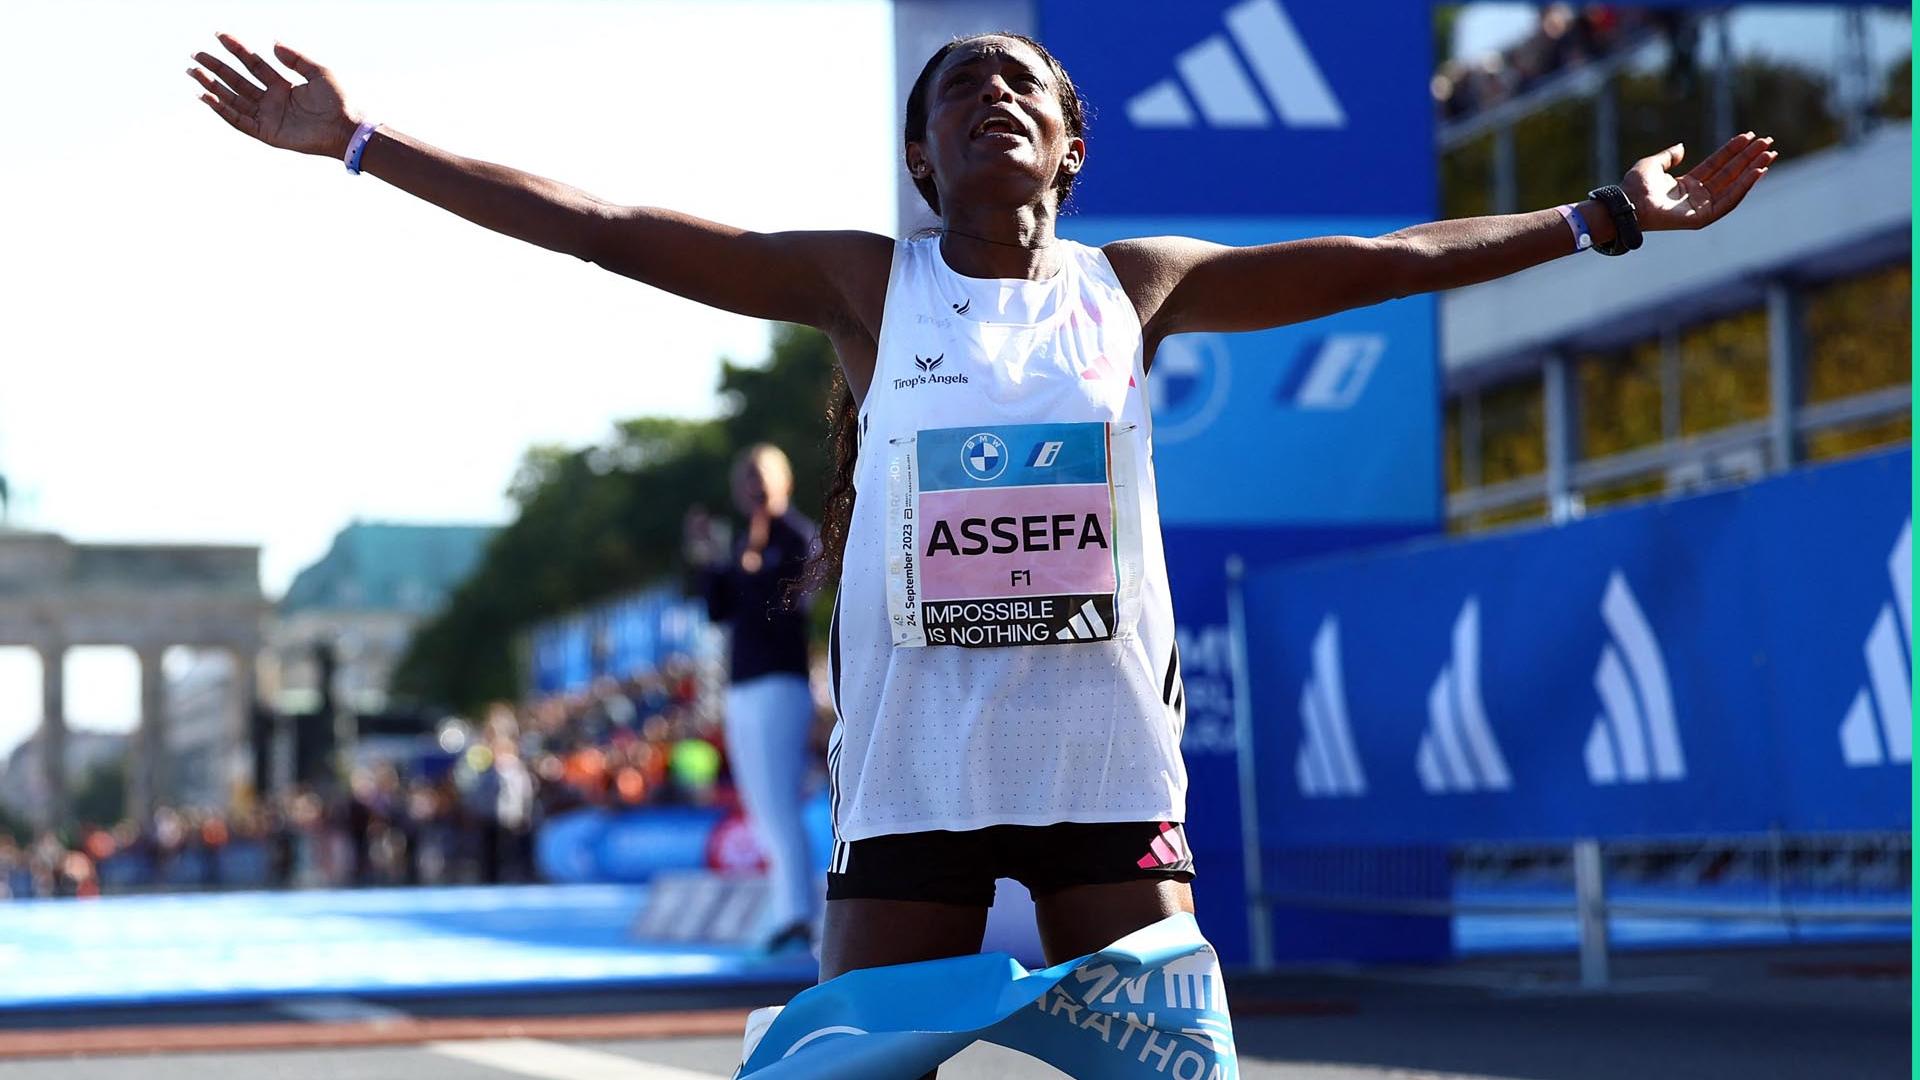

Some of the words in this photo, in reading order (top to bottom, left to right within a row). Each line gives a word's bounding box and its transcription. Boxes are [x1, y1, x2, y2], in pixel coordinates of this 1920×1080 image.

[894, 375, 926, 390] Tirop's
[928, 373, 969, 385] Angels
[966, 435, 1001, 450] BMW
[902, 524, 913, 550] 2023
[926, 513, 1108, 557] ASSEFA
[903, 552, 917, 609] September
[1011, 570, 1031, 586] F1
[906, 611, 917, 627] 24.
[926, 600, 1054, 624] IMPOSSIBLE
[928, 628, 947, 643] IS
[951, 623, 1050, 645] NOTHING
